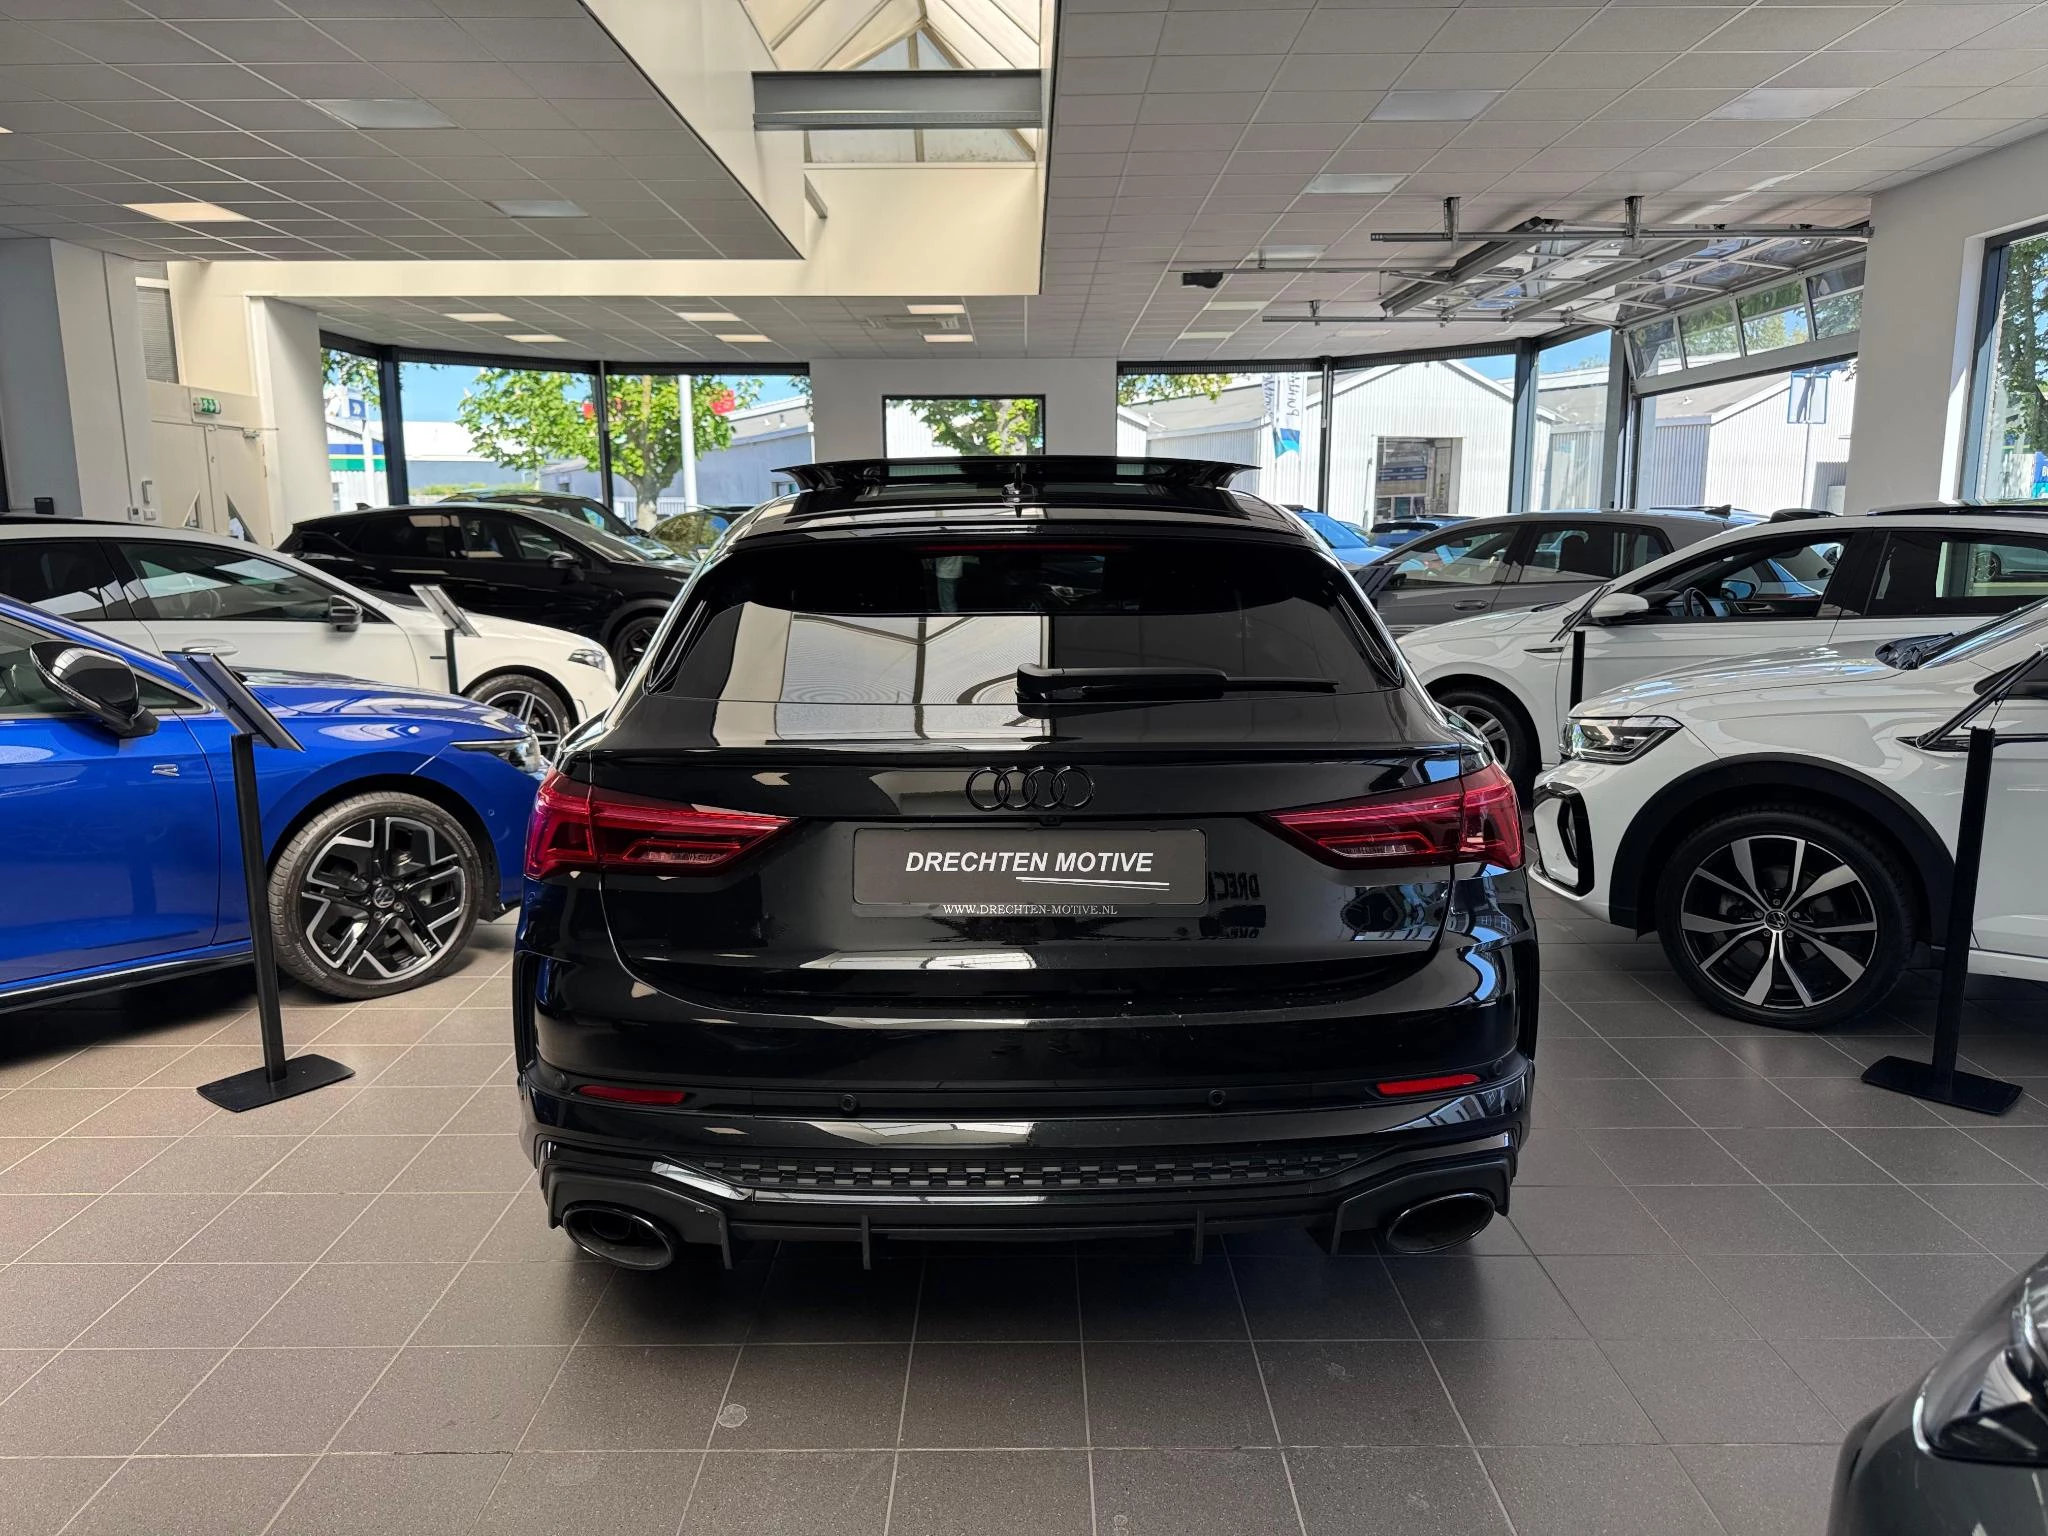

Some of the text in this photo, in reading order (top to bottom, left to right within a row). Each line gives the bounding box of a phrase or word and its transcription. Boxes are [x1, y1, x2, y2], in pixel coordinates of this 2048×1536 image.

[905, 851, 1154, 872] DRECHTEN MOTIVE
[942, 904, 1118, 915] WWW.DRECHTEN-MOTIVE.NL
